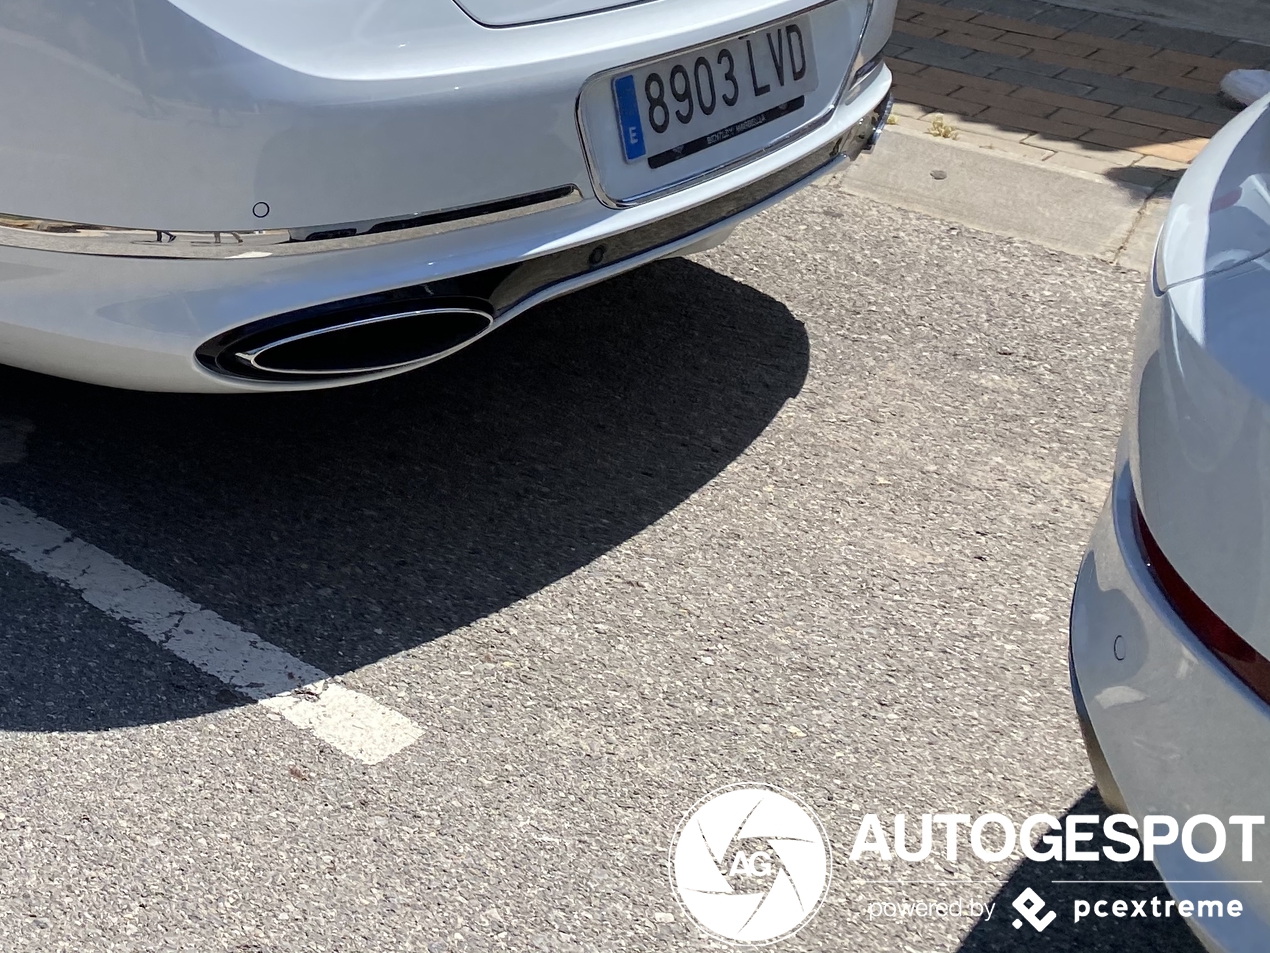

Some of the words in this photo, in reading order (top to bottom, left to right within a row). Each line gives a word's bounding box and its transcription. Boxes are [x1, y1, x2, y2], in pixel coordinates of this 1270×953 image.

[645, 48, 739, 133] 8903
[746, 24, 806, 96] LVD
[629, 126, 638, 144] E
